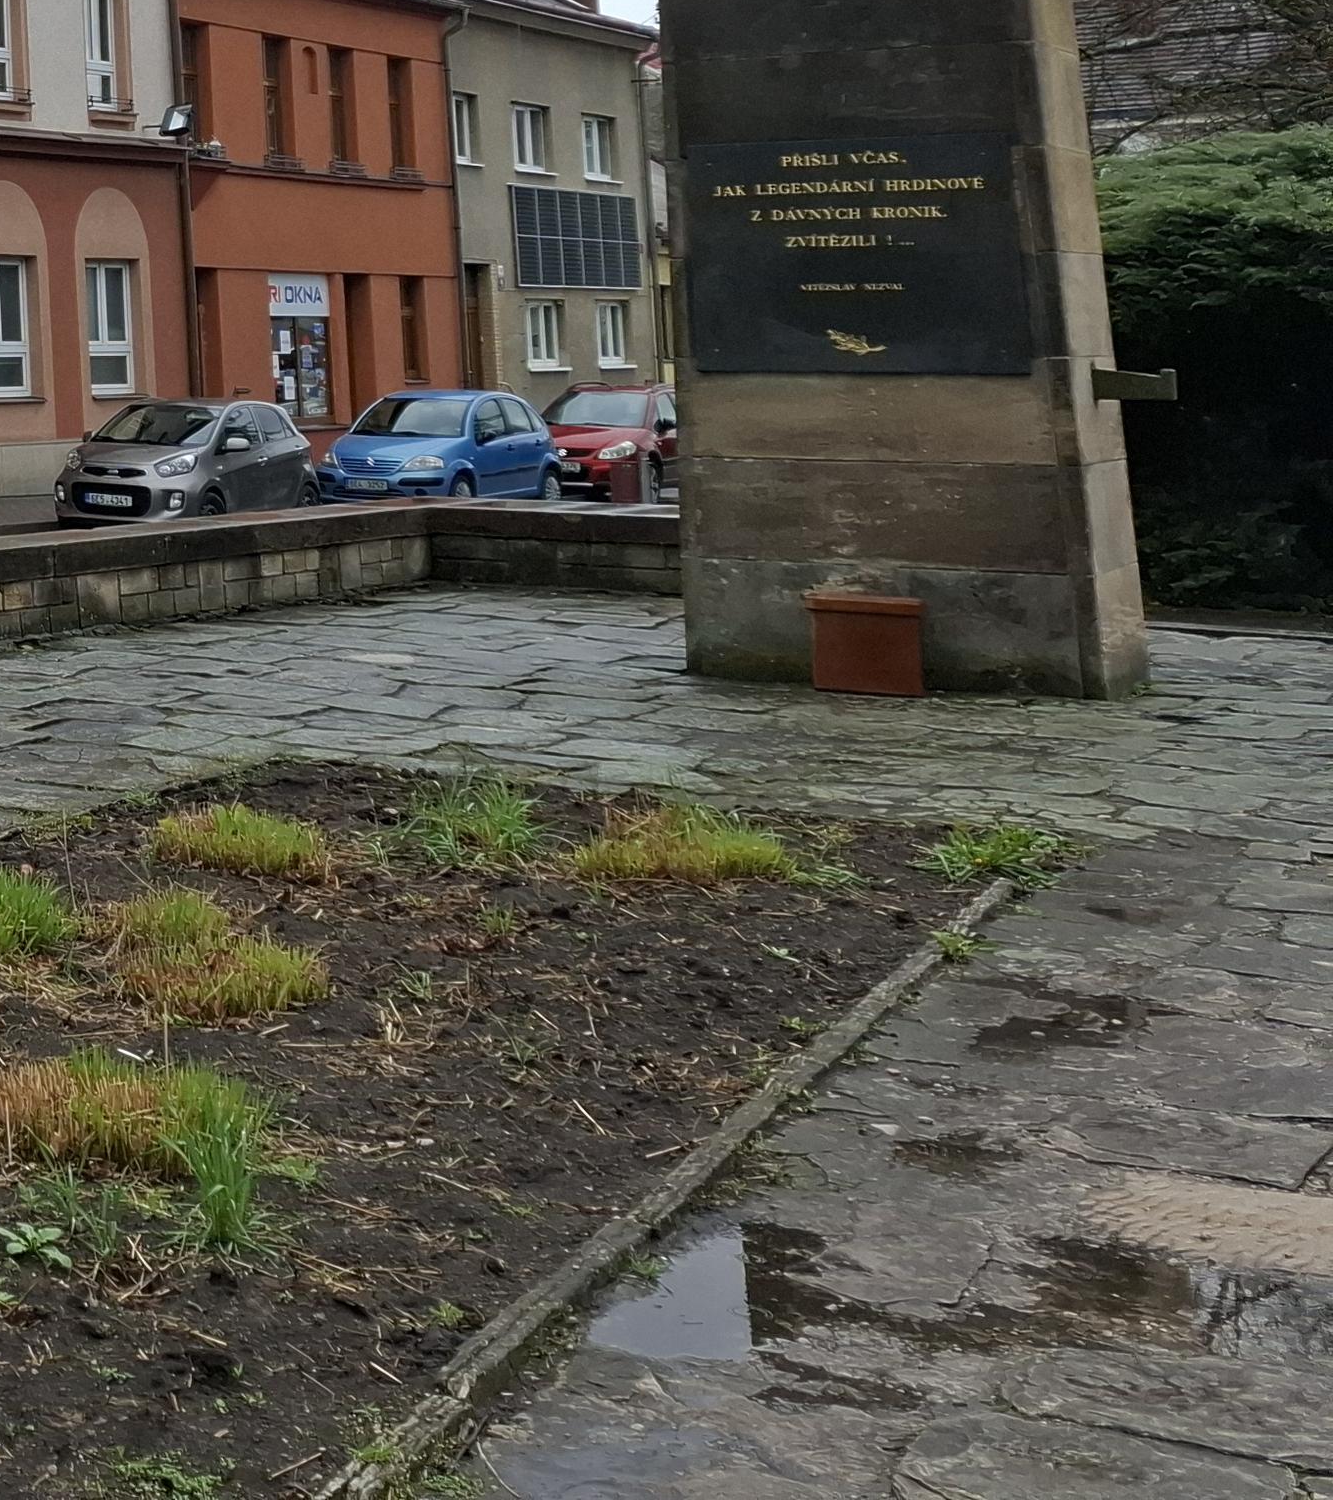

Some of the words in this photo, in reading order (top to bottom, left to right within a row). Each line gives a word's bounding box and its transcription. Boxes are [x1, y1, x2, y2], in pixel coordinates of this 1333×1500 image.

[712, 185, 746, 197] JAK
[756, 178, 875, 196] LEGENDÁRNÍ
[885, 176, 985, 192] HRDINOVÉ
[750, 210, 763, 222] Z
[772, 205, 861, 221] DÁVNÝCH
[285, 285, 323, 304] OKNA
